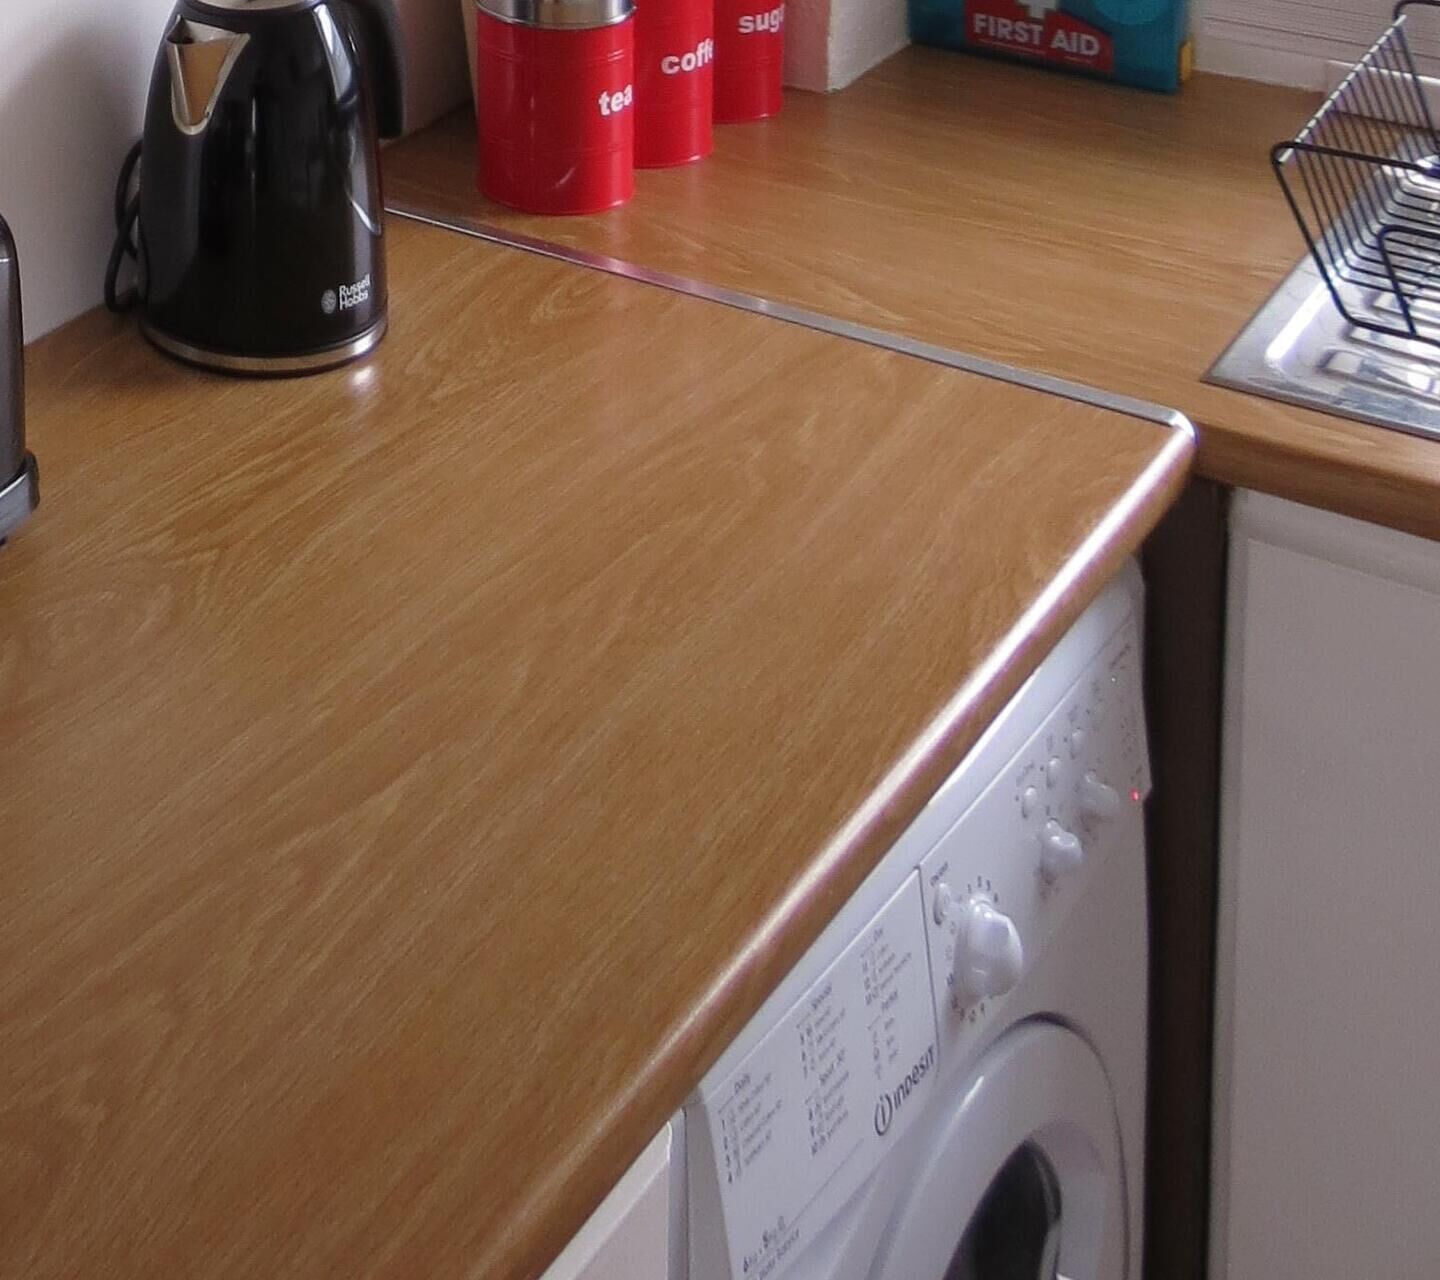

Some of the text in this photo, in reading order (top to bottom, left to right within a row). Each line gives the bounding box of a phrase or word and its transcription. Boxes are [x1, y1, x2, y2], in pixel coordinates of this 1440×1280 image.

[973, 13, 1044, 45] FIRST
[1050, 29, 1100, 56] AID
[598, 84, 632, 116] tea
[339, 273, 370, 297] Russell
[339, 290, 369, 310] Hobbs
